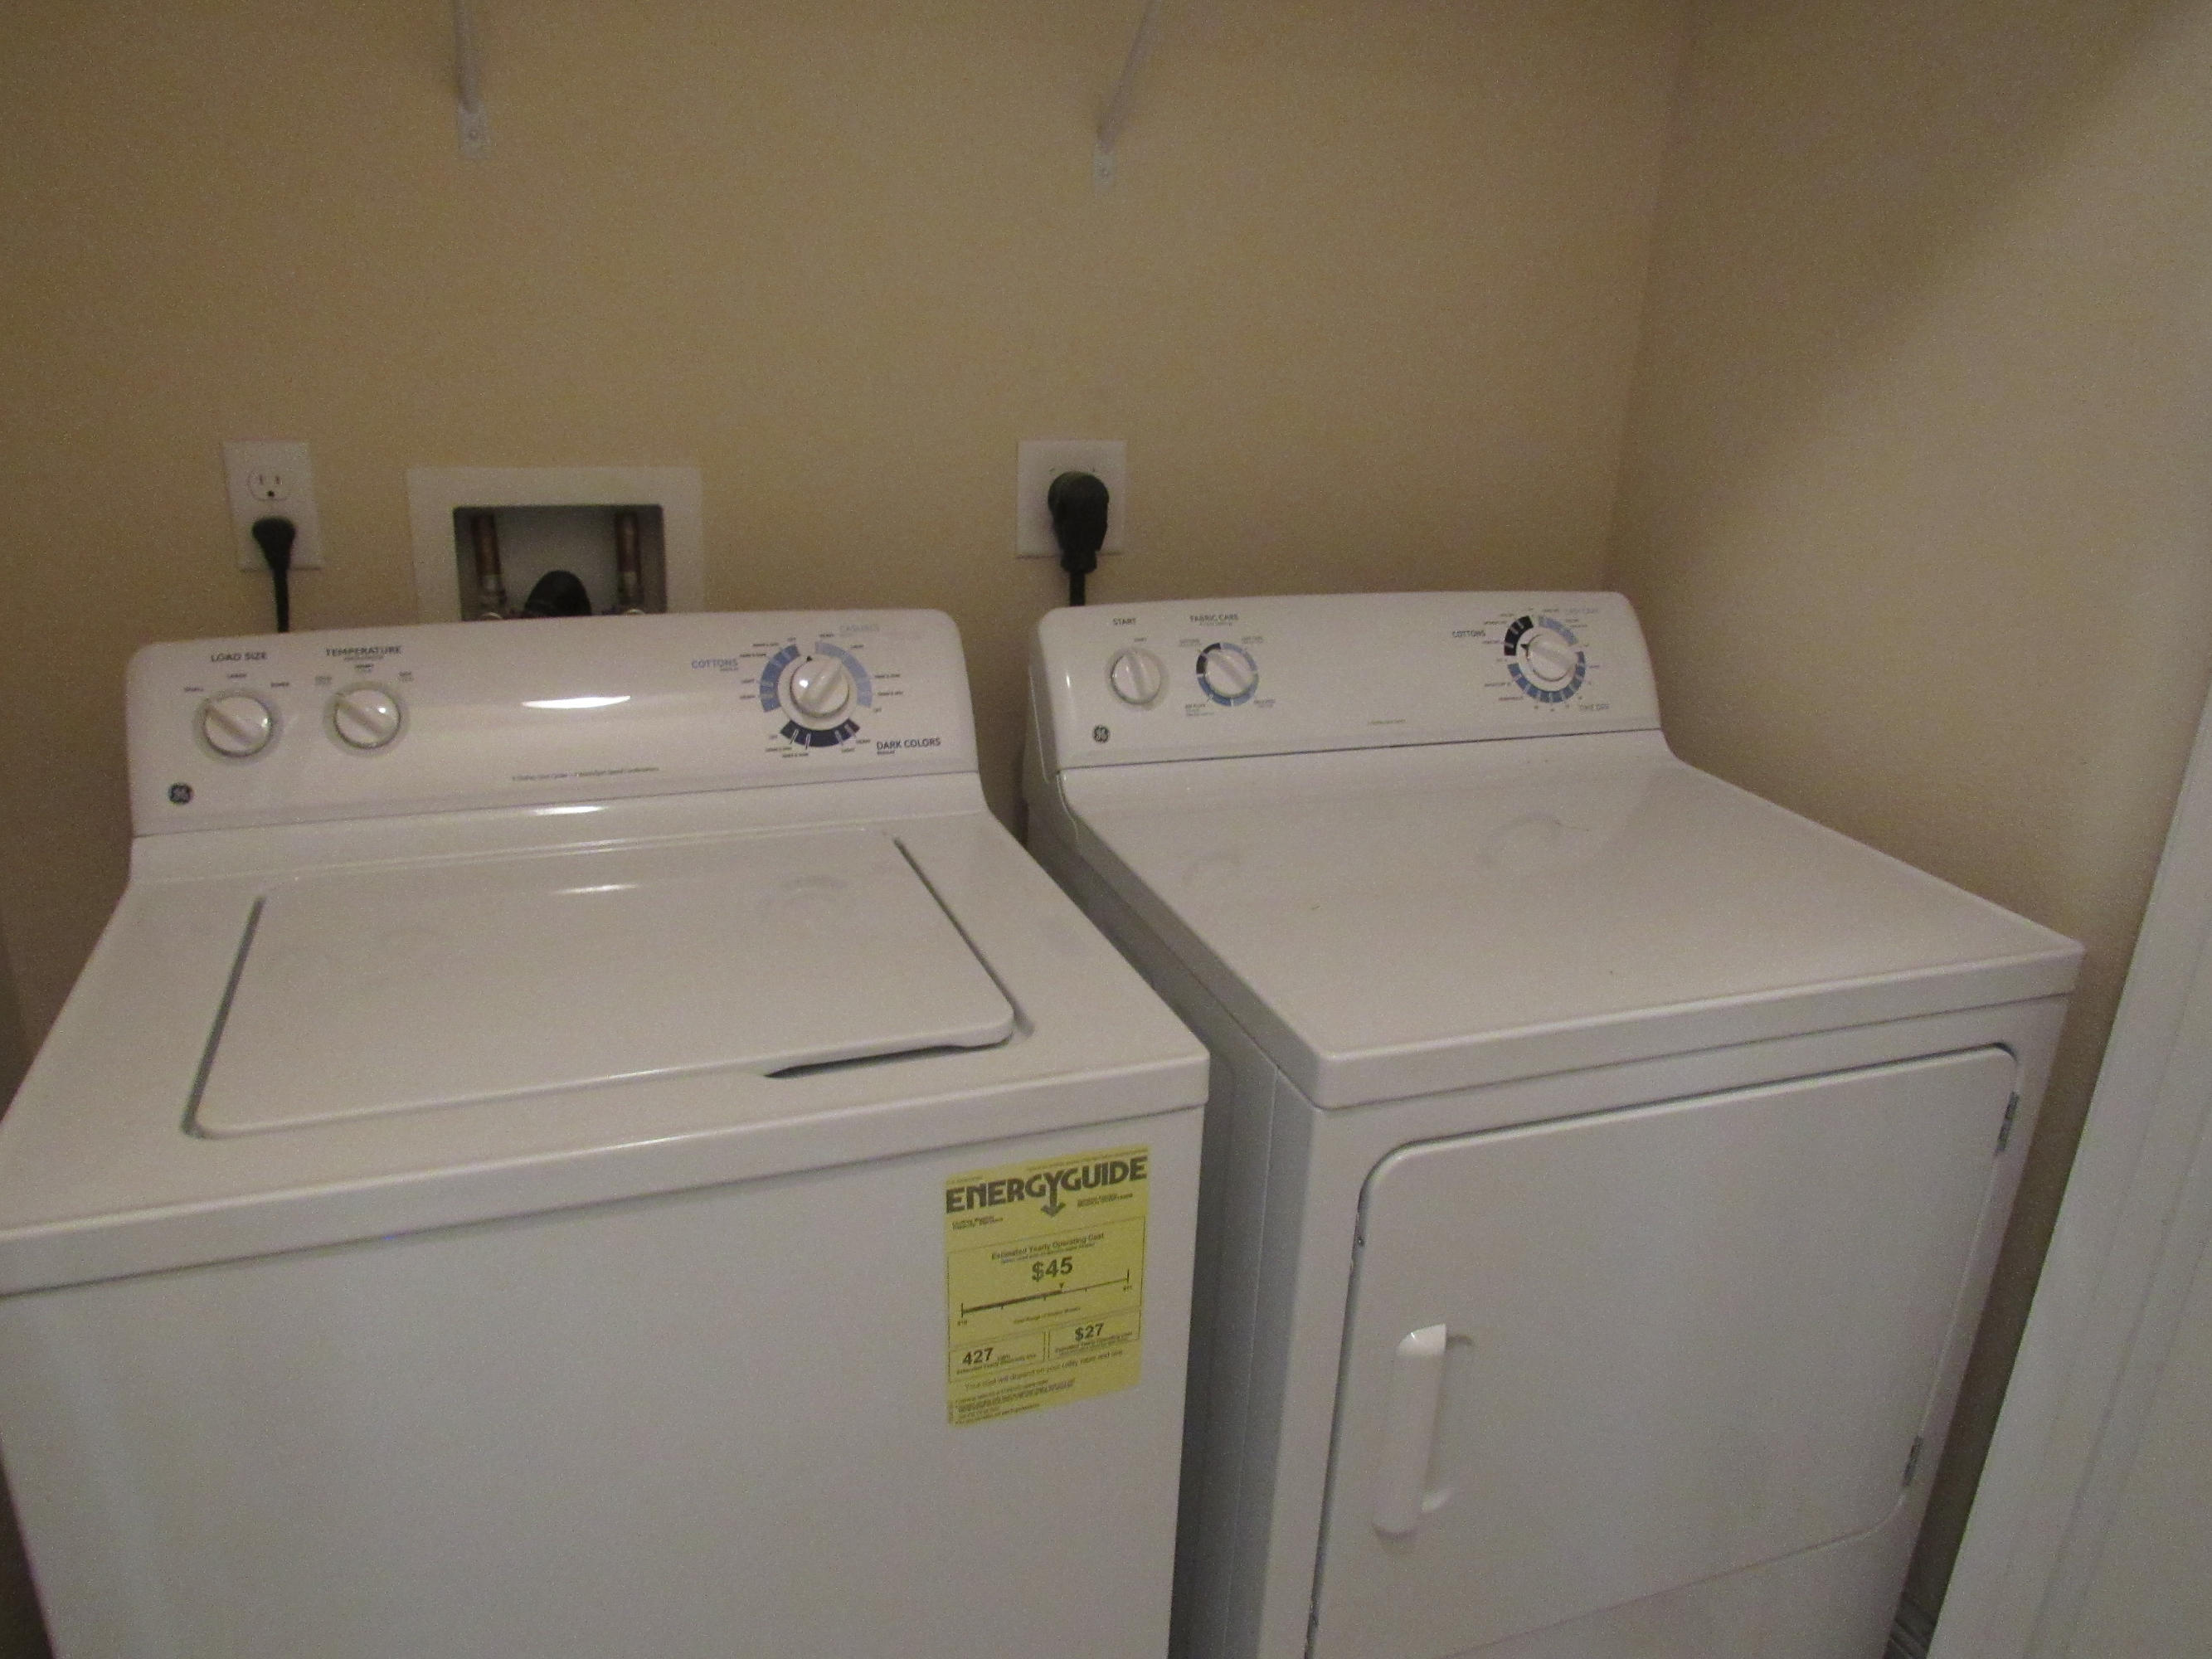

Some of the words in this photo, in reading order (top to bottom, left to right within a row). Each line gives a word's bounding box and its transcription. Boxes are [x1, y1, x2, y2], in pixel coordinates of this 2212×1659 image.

[1112, 617, 1137, 625] START
[210, 653, 241, 663] LOAD
[244, 650, 267, 661] SIZE
[326, 645, 402, 657] TEMPERATURE
[691, 658, 738, 670] COTTONS
[876, 739, 902, 751] DARK
[903, 737, 941, 749] COLORS
[946, 1155, 1148, 1216] ENERGYGUIDE
[1031, 1255, 1073, 1282] $45
[1074, 1321, 1105, 1342] $27
[962, 1346, 994, 1365] 427
